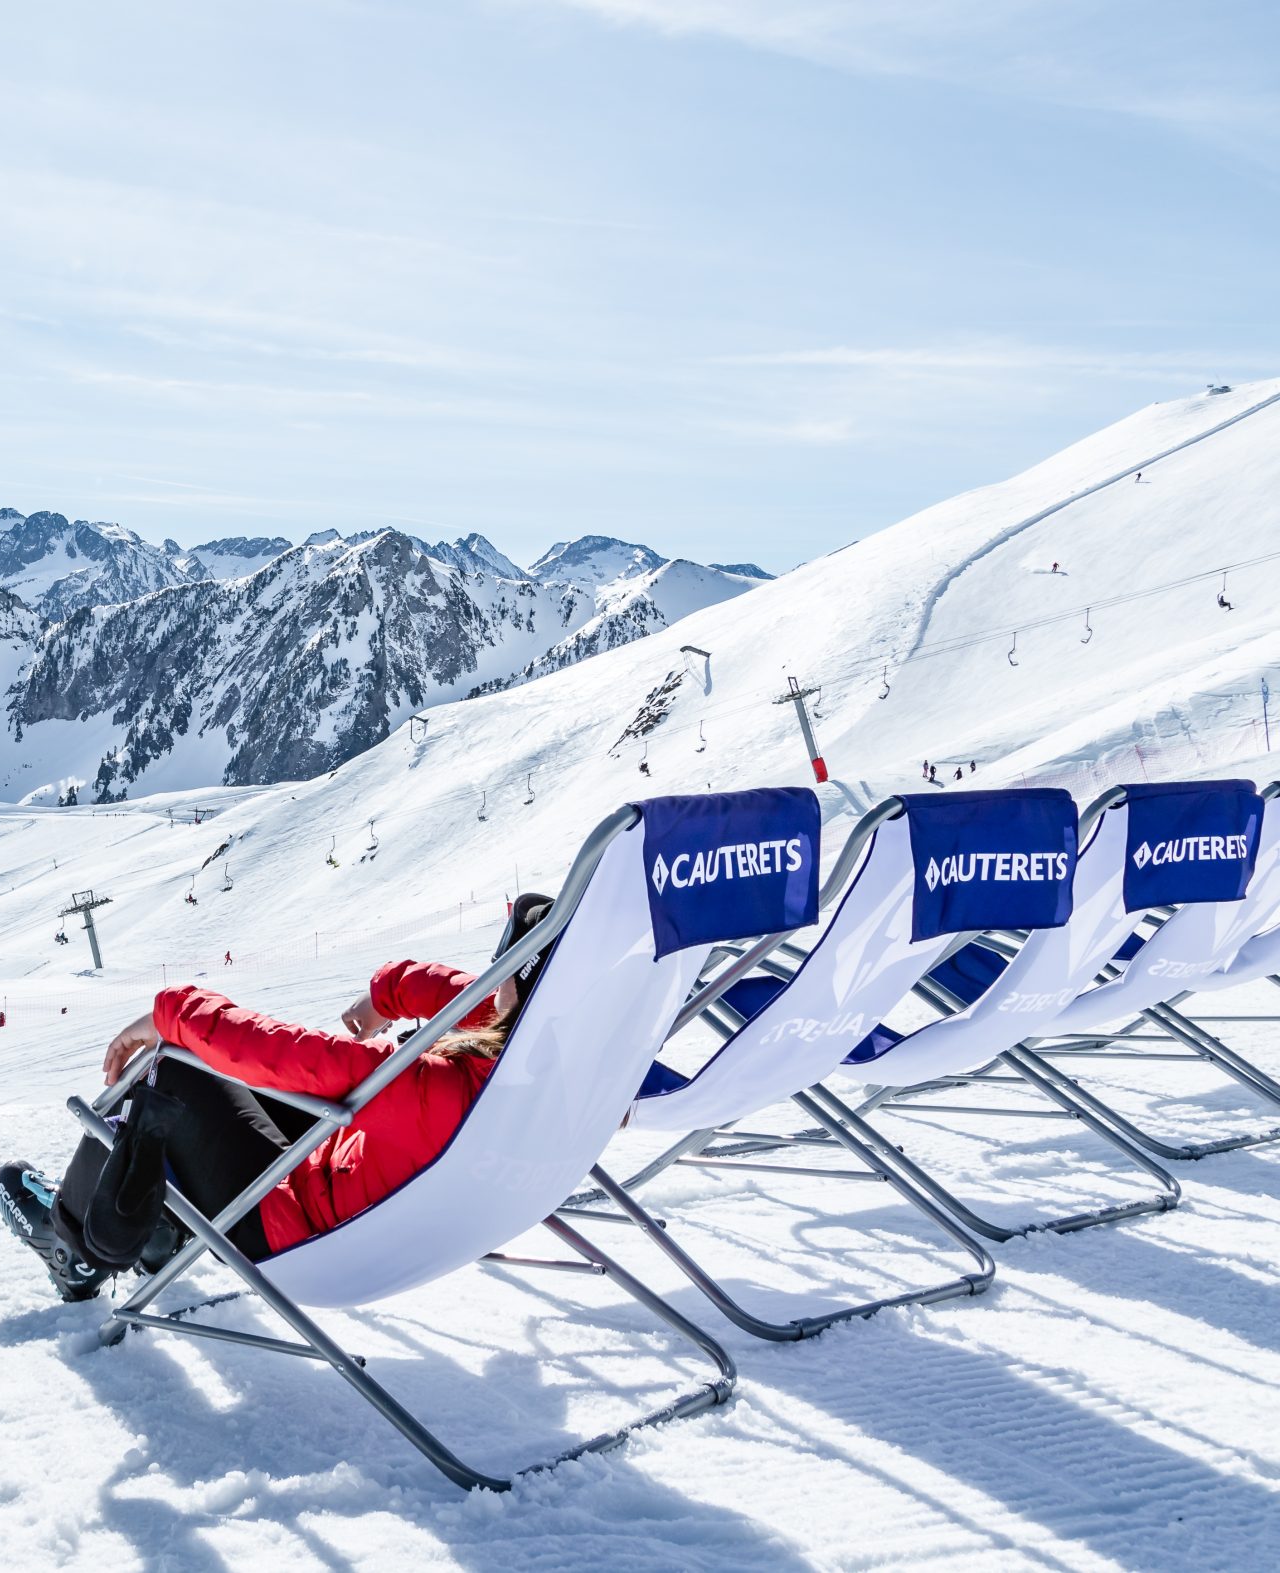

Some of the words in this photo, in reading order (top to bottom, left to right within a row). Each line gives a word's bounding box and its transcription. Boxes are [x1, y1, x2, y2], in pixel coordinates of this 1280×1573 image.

[670, 838, 803, 889] CAUTERETS
[1152, 834, 1247, 866] CAUTERETS
[941, 852, 1068, 886] CAUTERETS
[519, 953, 540, 980] IZIPIZI
